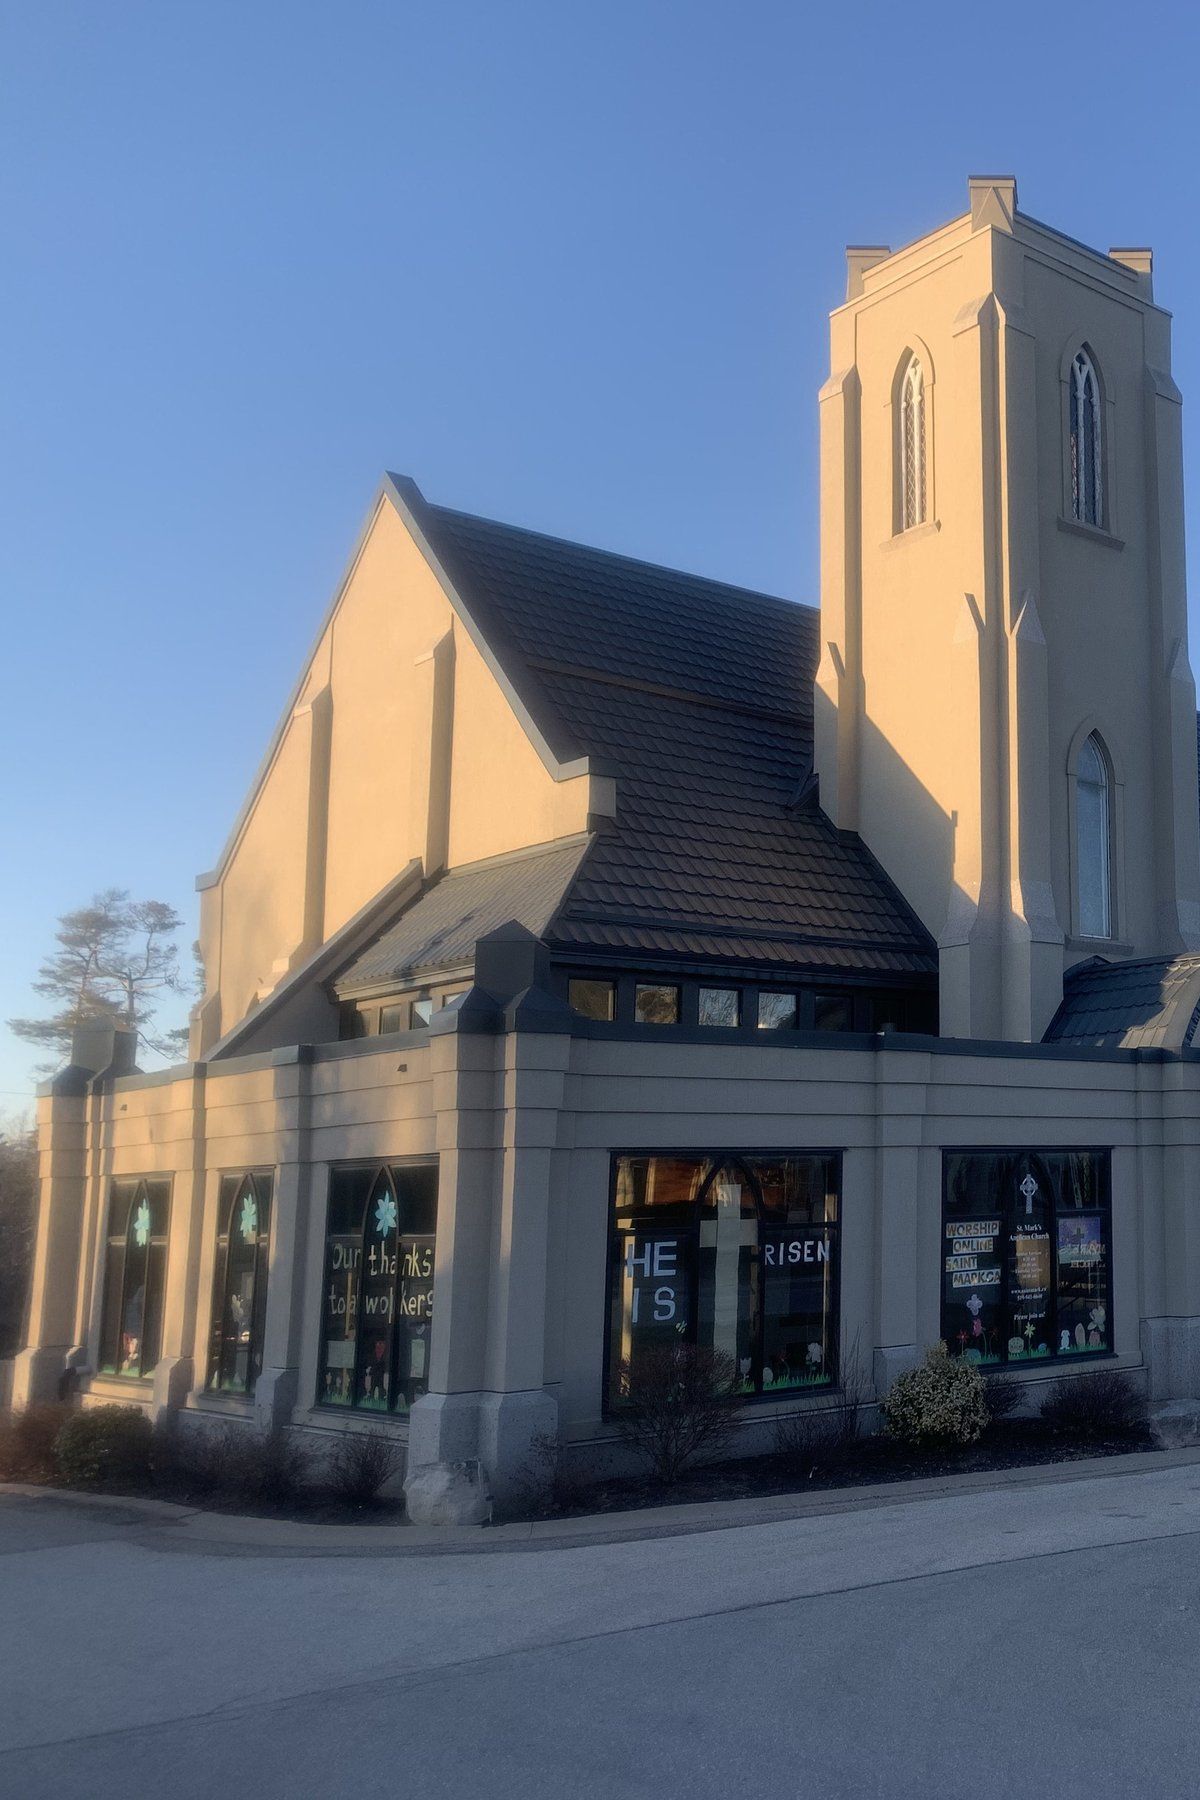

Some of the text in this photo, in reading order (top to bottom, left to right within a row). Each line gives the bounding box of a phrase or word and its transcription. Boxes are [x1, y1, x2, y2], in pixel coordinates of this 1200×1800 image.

[947, 1223, 998, 1237] WORSHIP
[1024, 1224, 1042, 1232] Mark's
[1031, 1232, 1050, 1240] Church
[954, 1239, 992, 1252] ONLINE
[332, 1240, 432, 1277] Our thanks
[626, 1240, 678, 1278] HE
[764, 1240, 831, 1266] RISEN
[946, 1256, 977, 1270] SAINT
[328, 1284, 346, 1315] to
